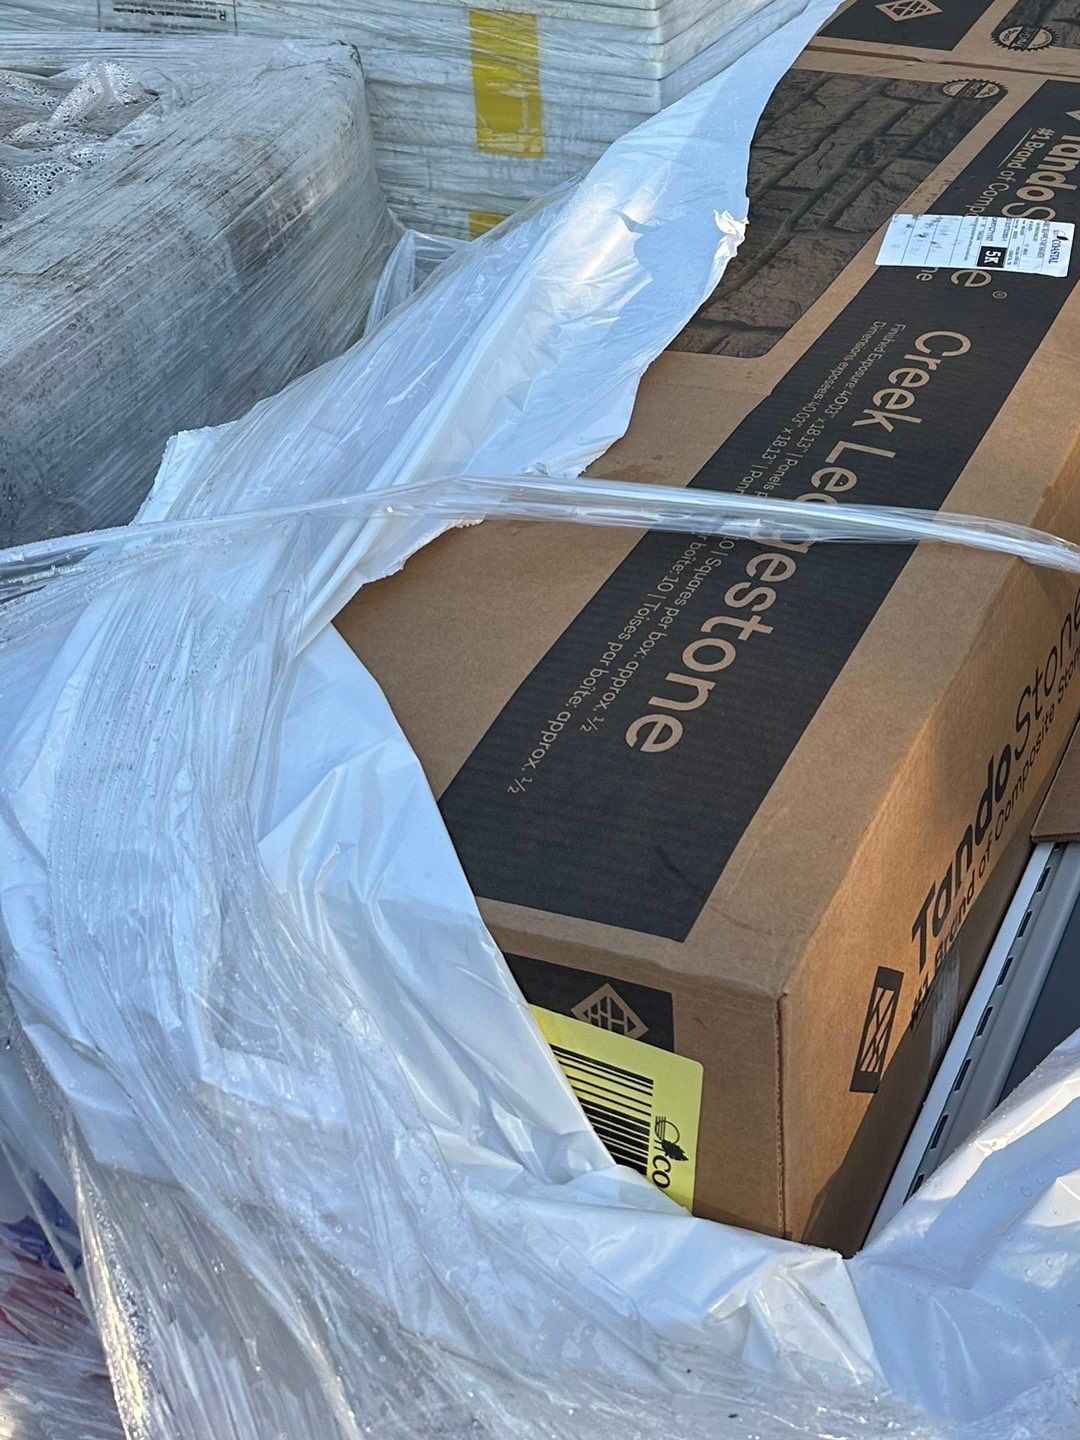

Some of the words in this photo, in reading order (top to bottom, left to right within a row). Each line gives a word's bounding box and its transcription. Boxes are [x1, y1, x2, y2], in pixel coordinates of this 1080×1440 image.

[1032, 127, 1055, 143] #1
[1009, 141, 1046, 170] Brand
[1000, 170, 1016, 182] of
[984, 251, 1001, 264] 5K
[1049, 238, 1060, 264] COASTAL
[848, 321, 887, 362] Dimensions
[876, 323, 906, 359] Finished
[852, 330, 972, 432] Creek
[768, 453, 798, 492] Panels
[668, 542, 707, 576] boîte:
[657, 576, 679, 593] 10
[674, 557, 722, 606] Squares
[618, 601, 660, 640] Toises
[658, 606, 680, 630] per
[600, 641, 624, 668] par
[637, 632, 668, 659] box:
[565, 668, 609, 708] boîte:
[592, 661, 639, 712] approx.
[521, 711, 571, 772] approx.
[978, 830, 992, 880] of
[994, 703, 1056, 842] Composite
